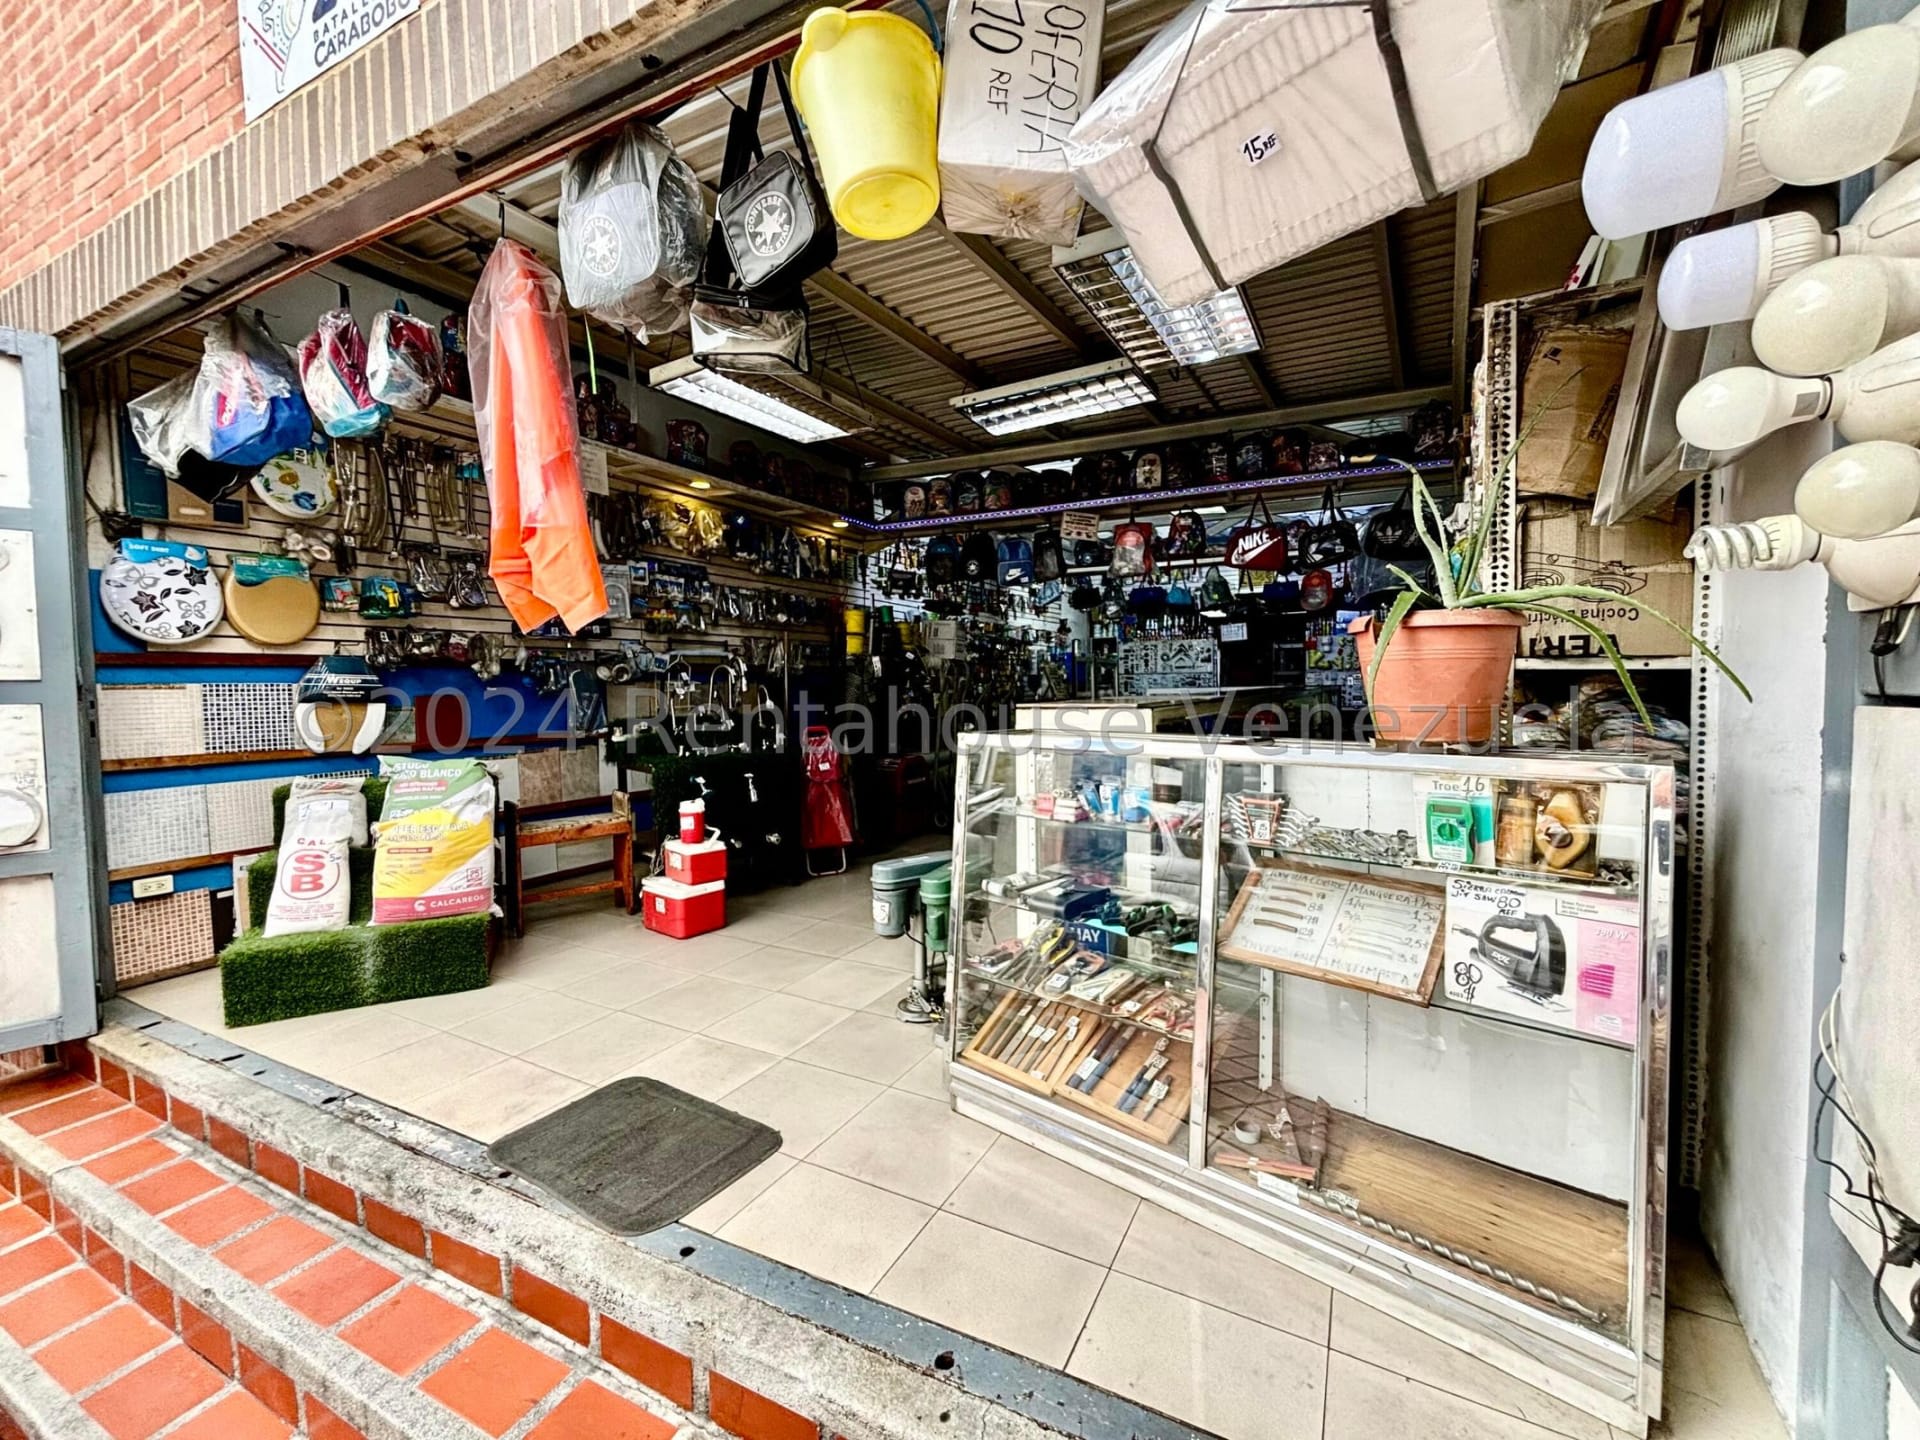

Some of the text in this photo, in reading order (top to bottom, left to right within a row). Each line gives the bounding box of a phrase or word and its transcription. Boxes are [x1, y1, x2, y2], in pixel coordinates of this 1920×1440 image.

[1016, 4, 1087, 154] OFERTA
[986, 67, 1012, 116] REF
[1243, 135, 1265, 162] 15
[1238, 528, 1271, 554] NIKE
[1580, 606, 1640, 622] Cocina
[419, 768, 463, 779] BLANCO
[1463, 775, 1486, 793] 16
[296, 836, 327, 848] CAL
[1496, 895, 1521, 909] 80
[1453, 961, 1484, 987] 80
